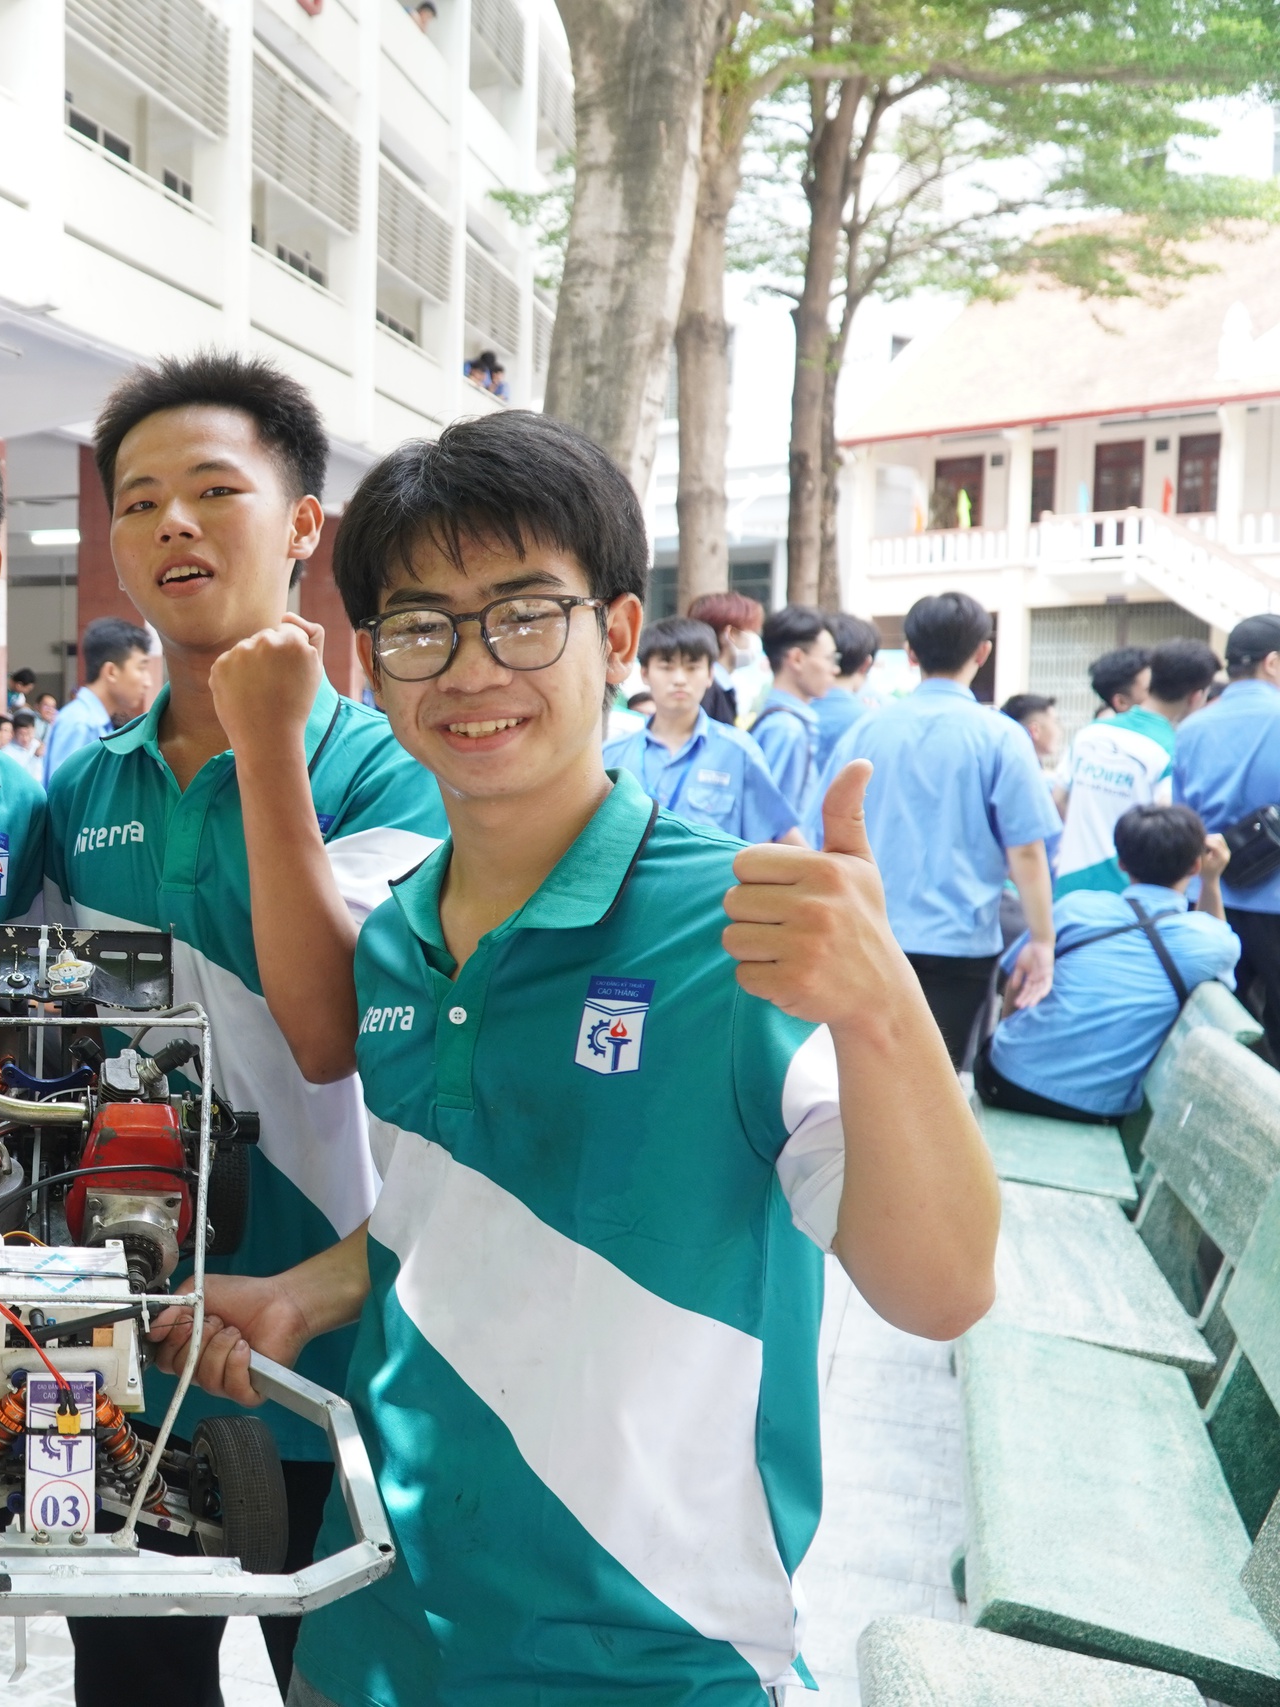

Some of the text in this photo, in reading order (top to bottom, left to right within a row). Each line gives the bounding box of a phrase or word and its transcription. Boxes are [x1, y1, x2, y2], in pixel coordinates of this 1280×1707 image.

[597, 987, 612, 995] CAO
[42, 1391, 57, 1400] CAO
[40, 1495, 81, 1527] 03
